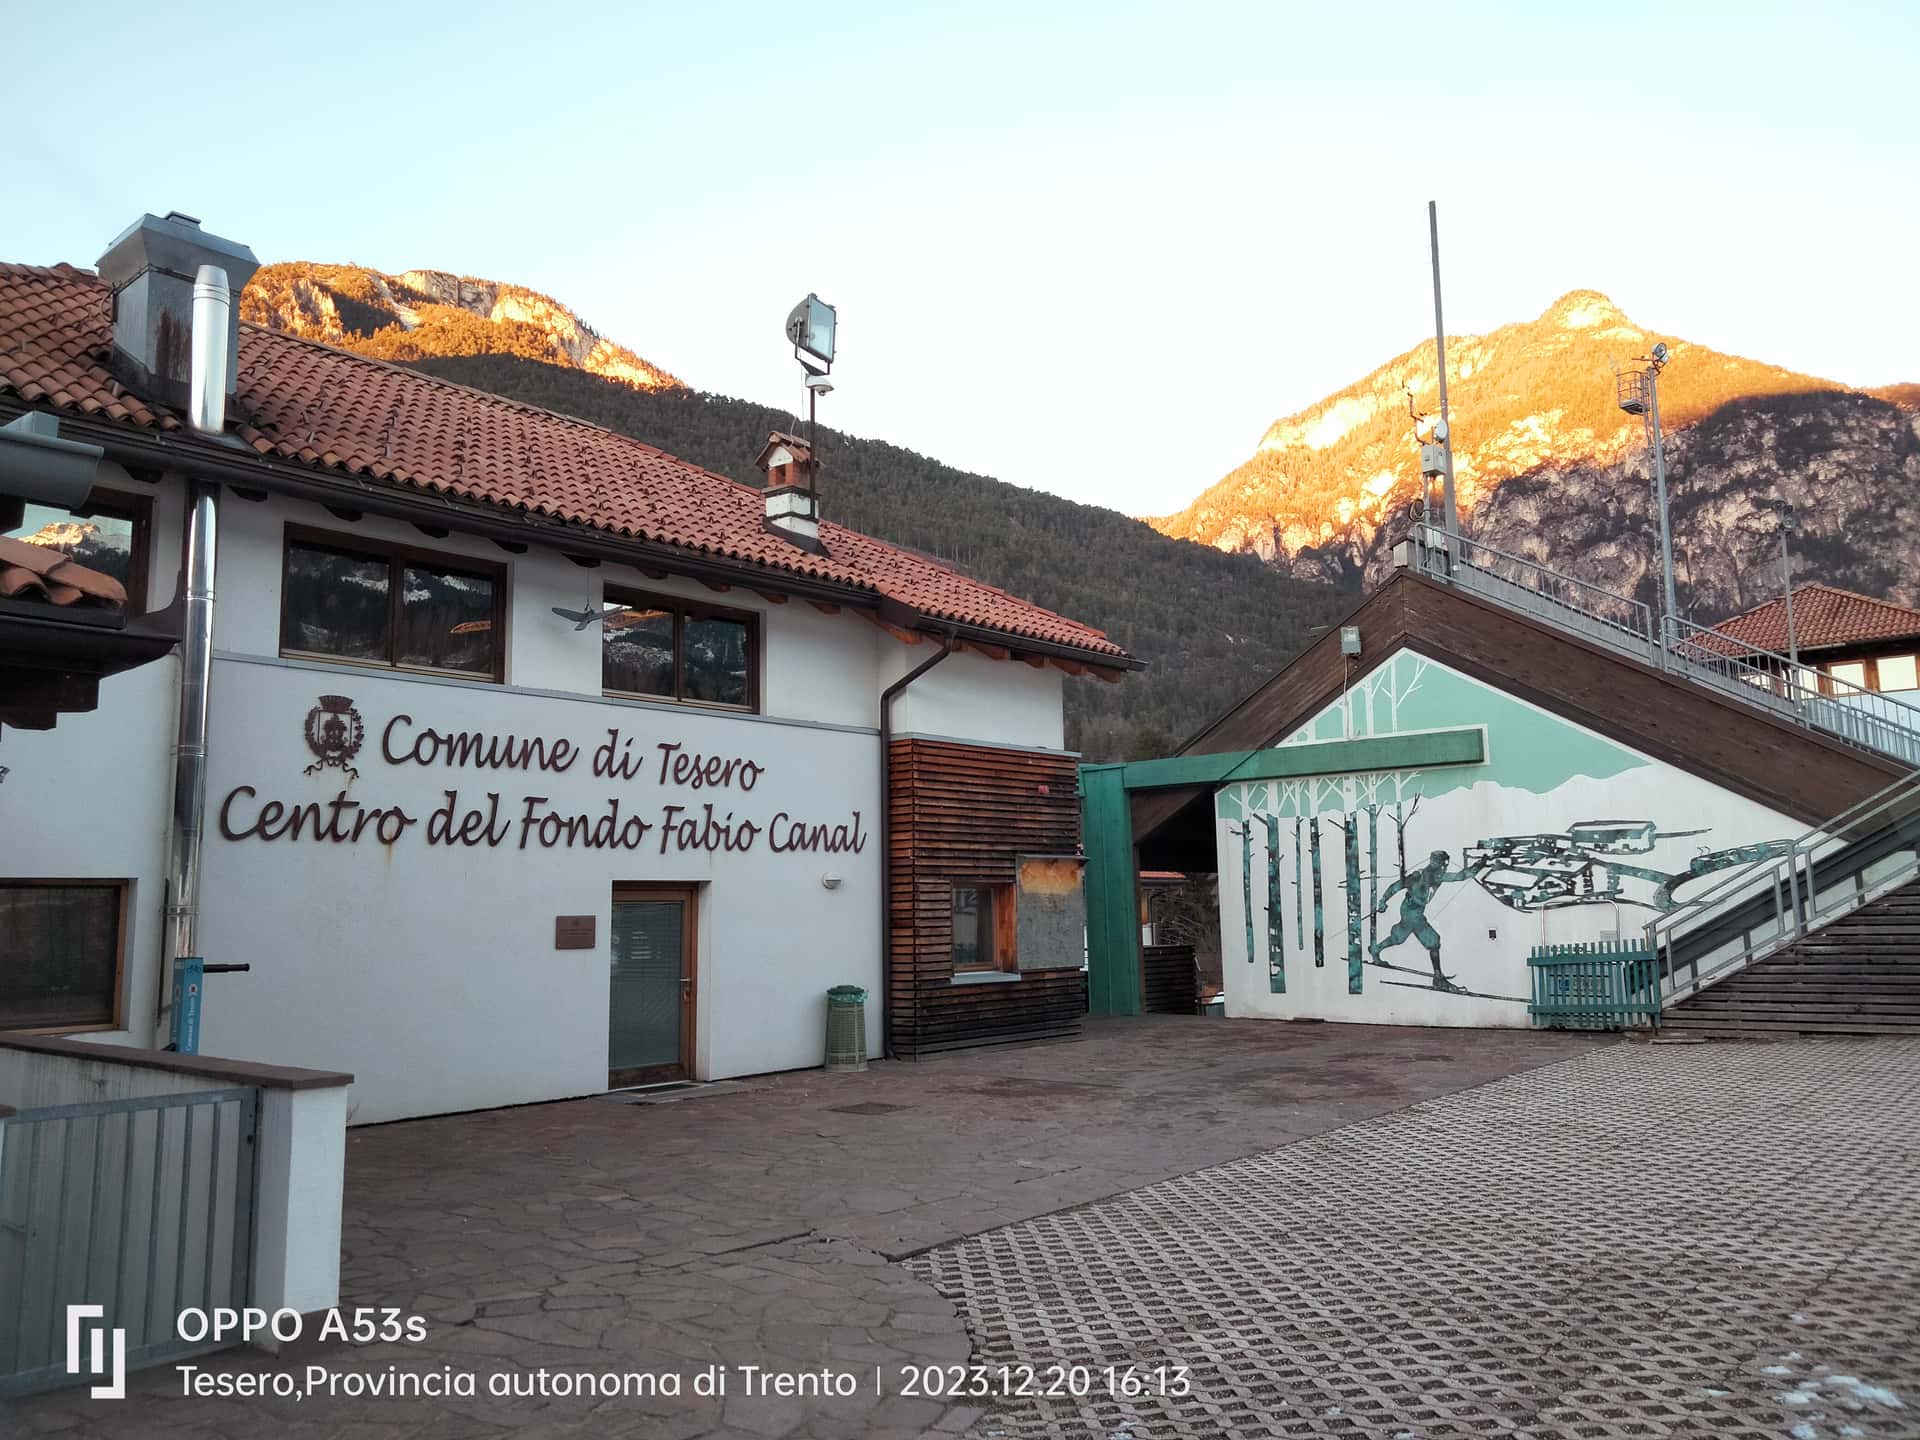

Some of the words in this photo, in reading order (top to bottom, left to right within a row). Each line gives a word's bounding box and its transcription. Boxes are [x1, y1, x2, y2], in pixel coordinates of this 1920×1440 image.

[382, 714, 579, 772] Comune
[593, 728, 643, 781] di
[657, 741, 765, 792] Tesero
[218, 785, 417, 848] Centro
[427, 790, 510, 848] del
[519, 796, 652, 850] Fondo
[659, 803, 762, 855] Fabio
[768, 811, 867, 854] Canal
